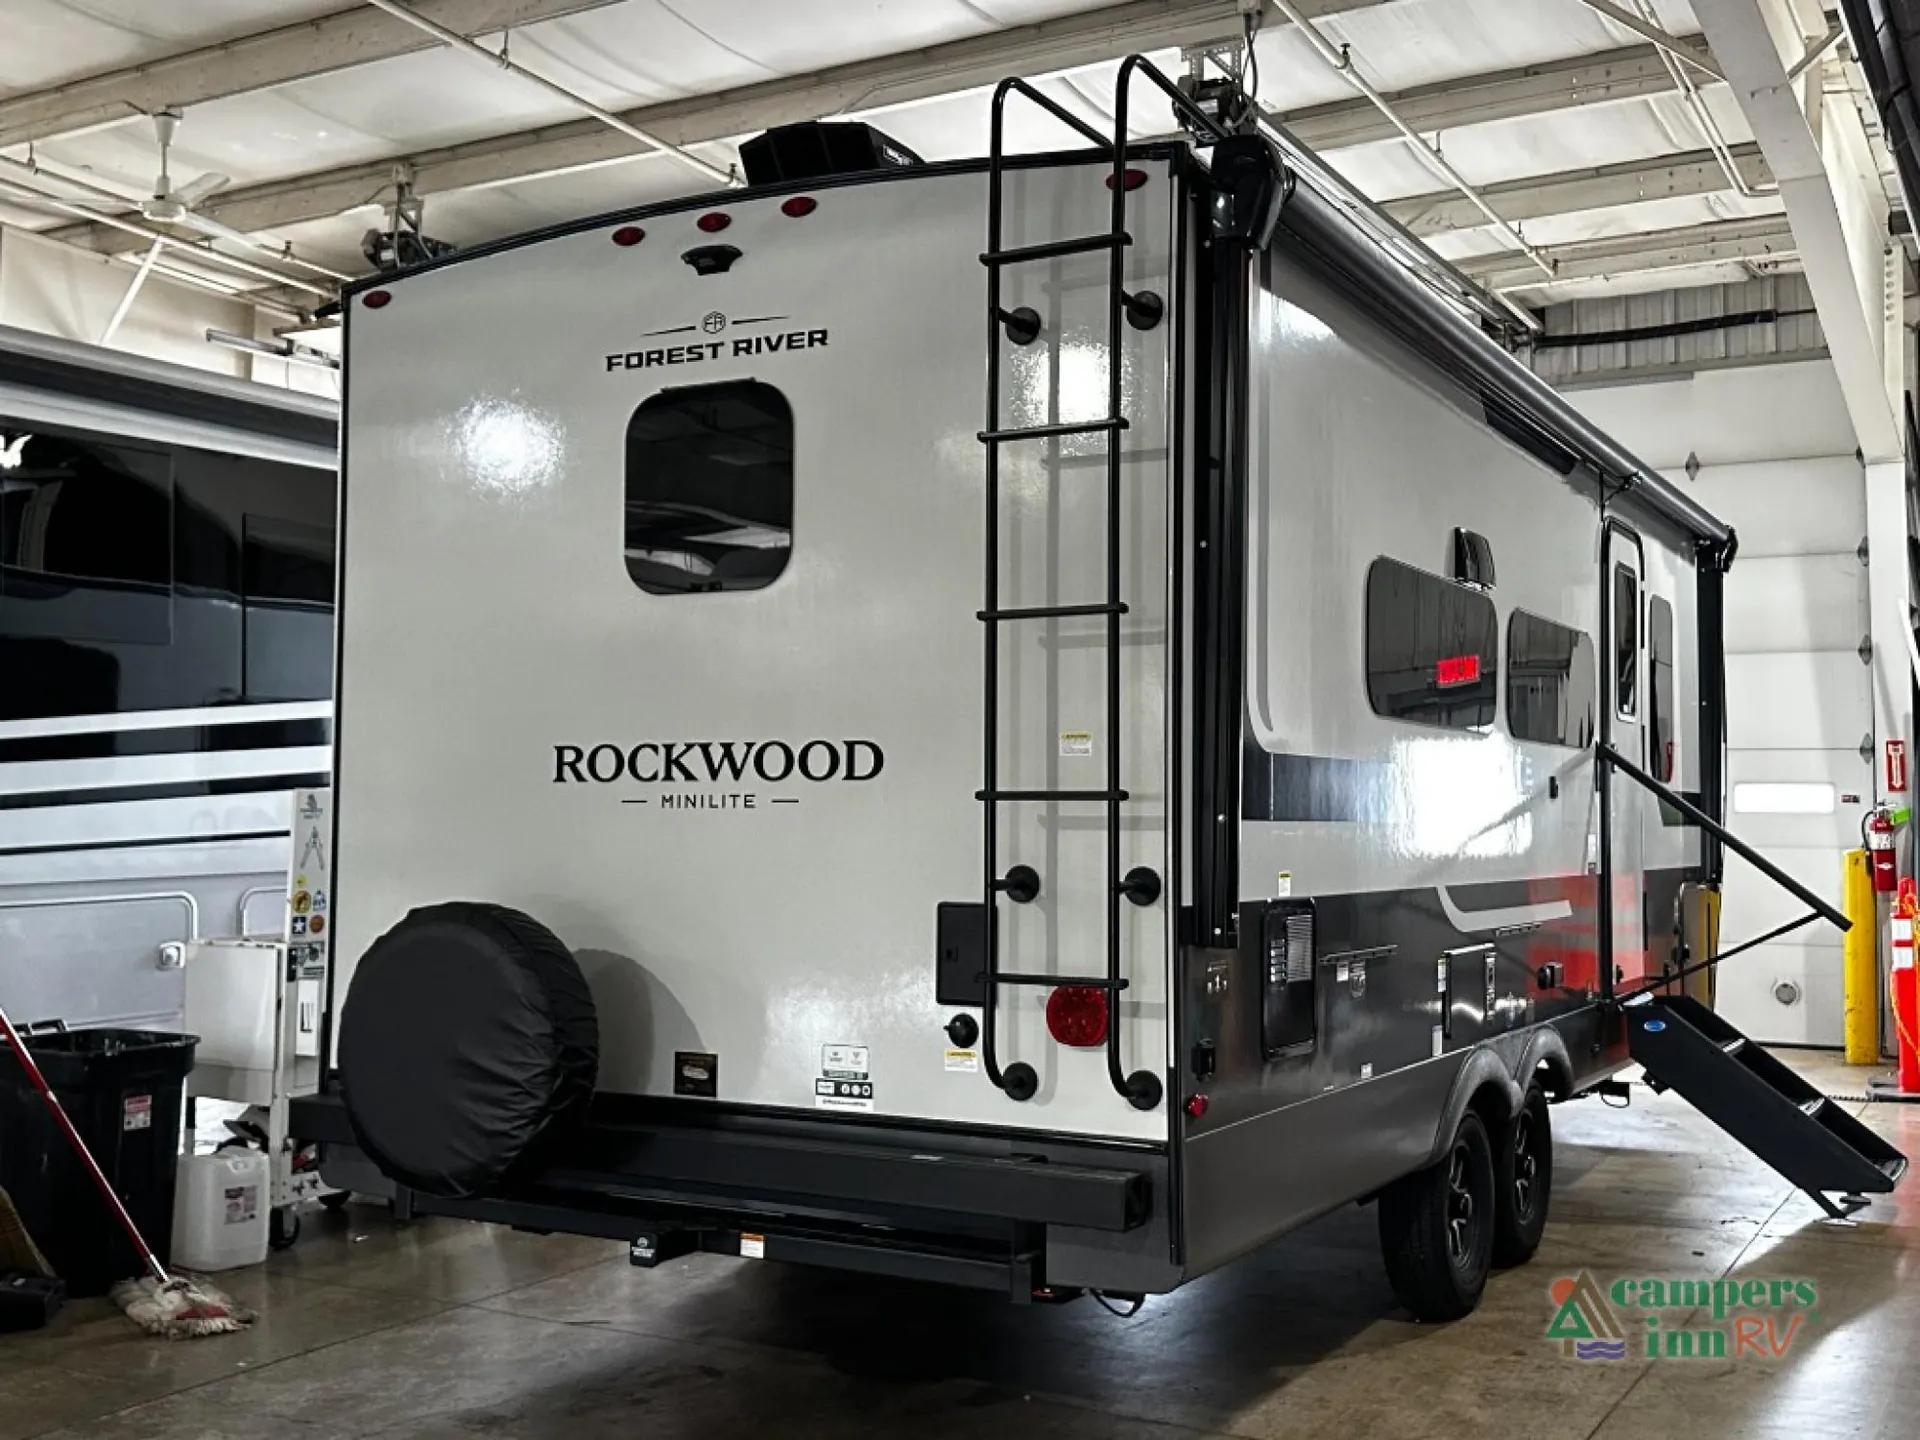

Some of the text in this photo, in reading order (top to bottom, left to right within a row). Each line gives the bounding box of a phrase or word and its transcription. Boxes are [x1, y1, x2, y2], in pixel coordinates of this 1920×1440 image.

[605, 328, 829, 372] FOREST RIVER
[552, 740, 885, 783] ROCKWOOD
[660, 794, 757, 809] MINILITE
